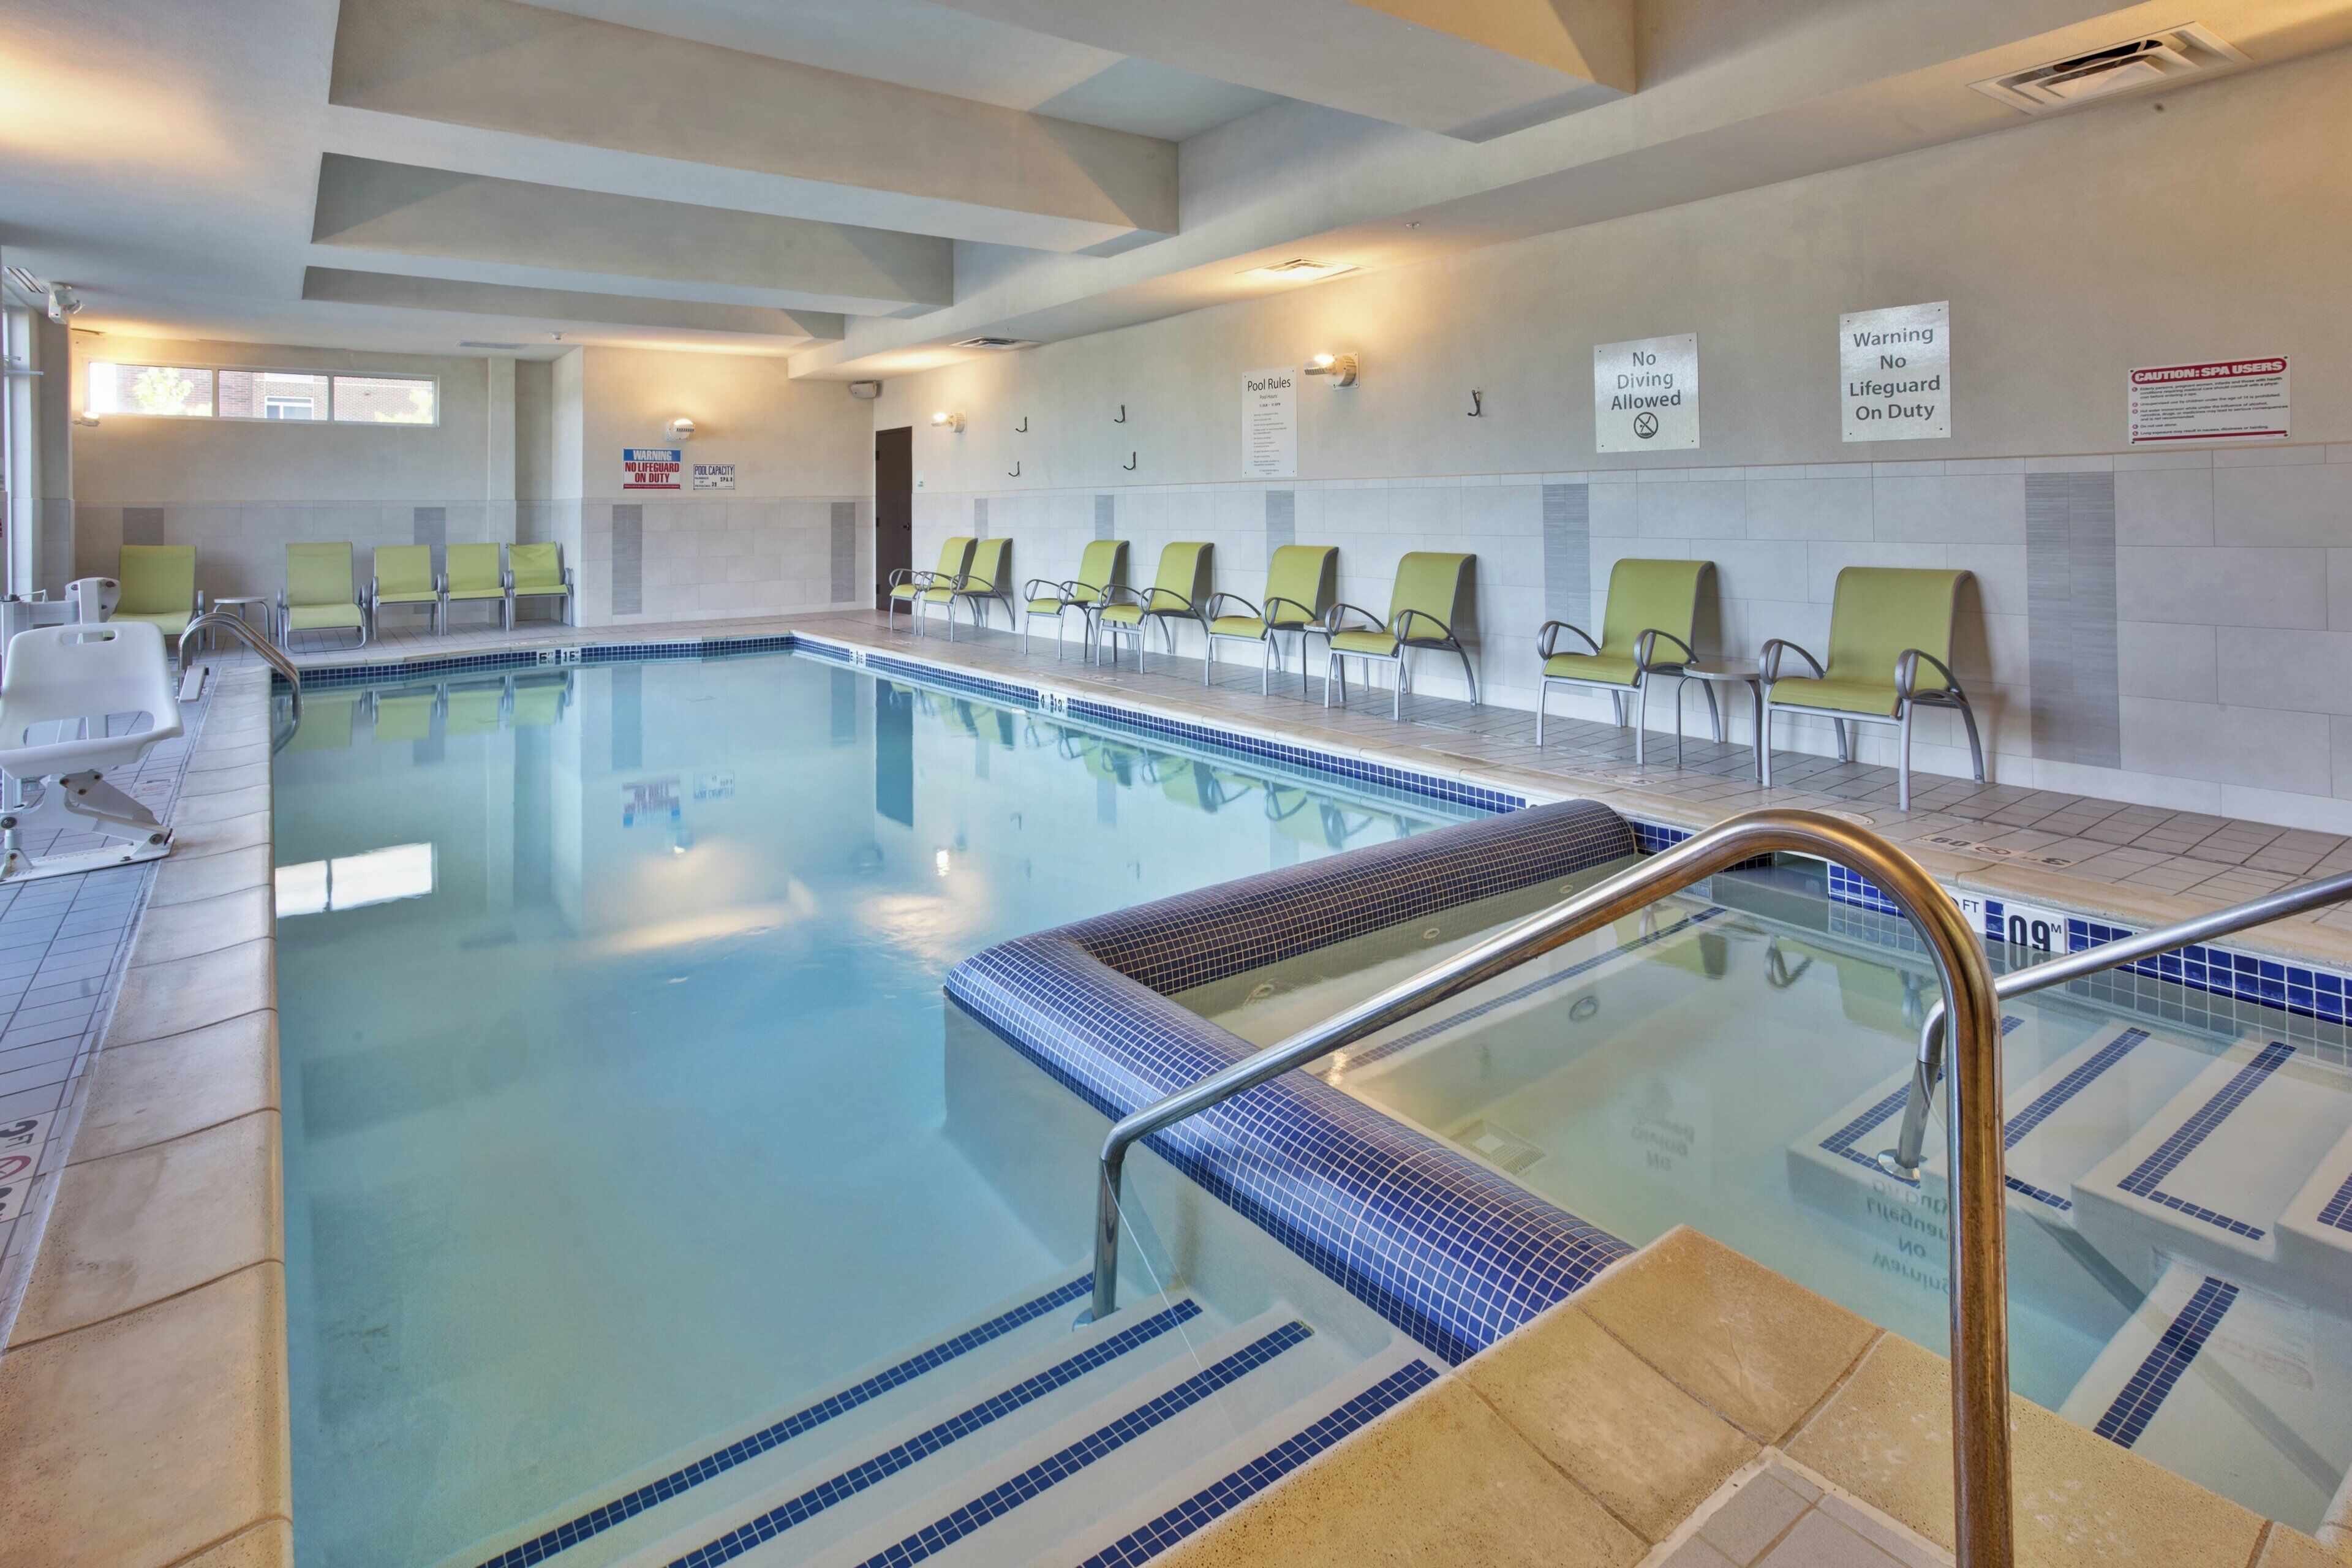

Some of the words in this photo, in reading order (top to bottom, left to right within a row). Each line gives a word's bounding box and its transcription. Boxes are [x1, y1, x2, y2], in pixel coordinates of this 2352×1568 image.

[1853, 328, 1933, 347] Warning
[1633, 352, 1656, 367] No
[1880, 355, 1906, 369] No
[2135, 368, 2199, 382] CAUTION:
[2201, 366, 2230, 377] SPA
[2231, 361, 2282, 374] USERS
[1248, 379, 1265, 392] Pool
[1268, 377, 1291, 390] Rules
[1618, 372, 1673, 389] Diving
[1850, 375, 1940, 398] Lifeguard
[1611, 390, 1681, 410] Allowed
[1856, 406, 1882, 420] On
[1888, 404, 1935, 421] Duty
[633, 450, 672, 461] WARNING
[625, 462, 636, 472] NO
[638, 462, 679, 472] LIFEGUARD
[695, 466, 707, 475] POOL
[709, 466, 734, 475] CAPACITY
[635, 473, 646, 483] ON
[649, 473, 669, 483] DUTY
[1963, 899, 1979, 913] FT
[2009, 914, 2050, 951] 09
[2051, 923, 2062, 934] M
[6, 1133, 34, 1148] FT
